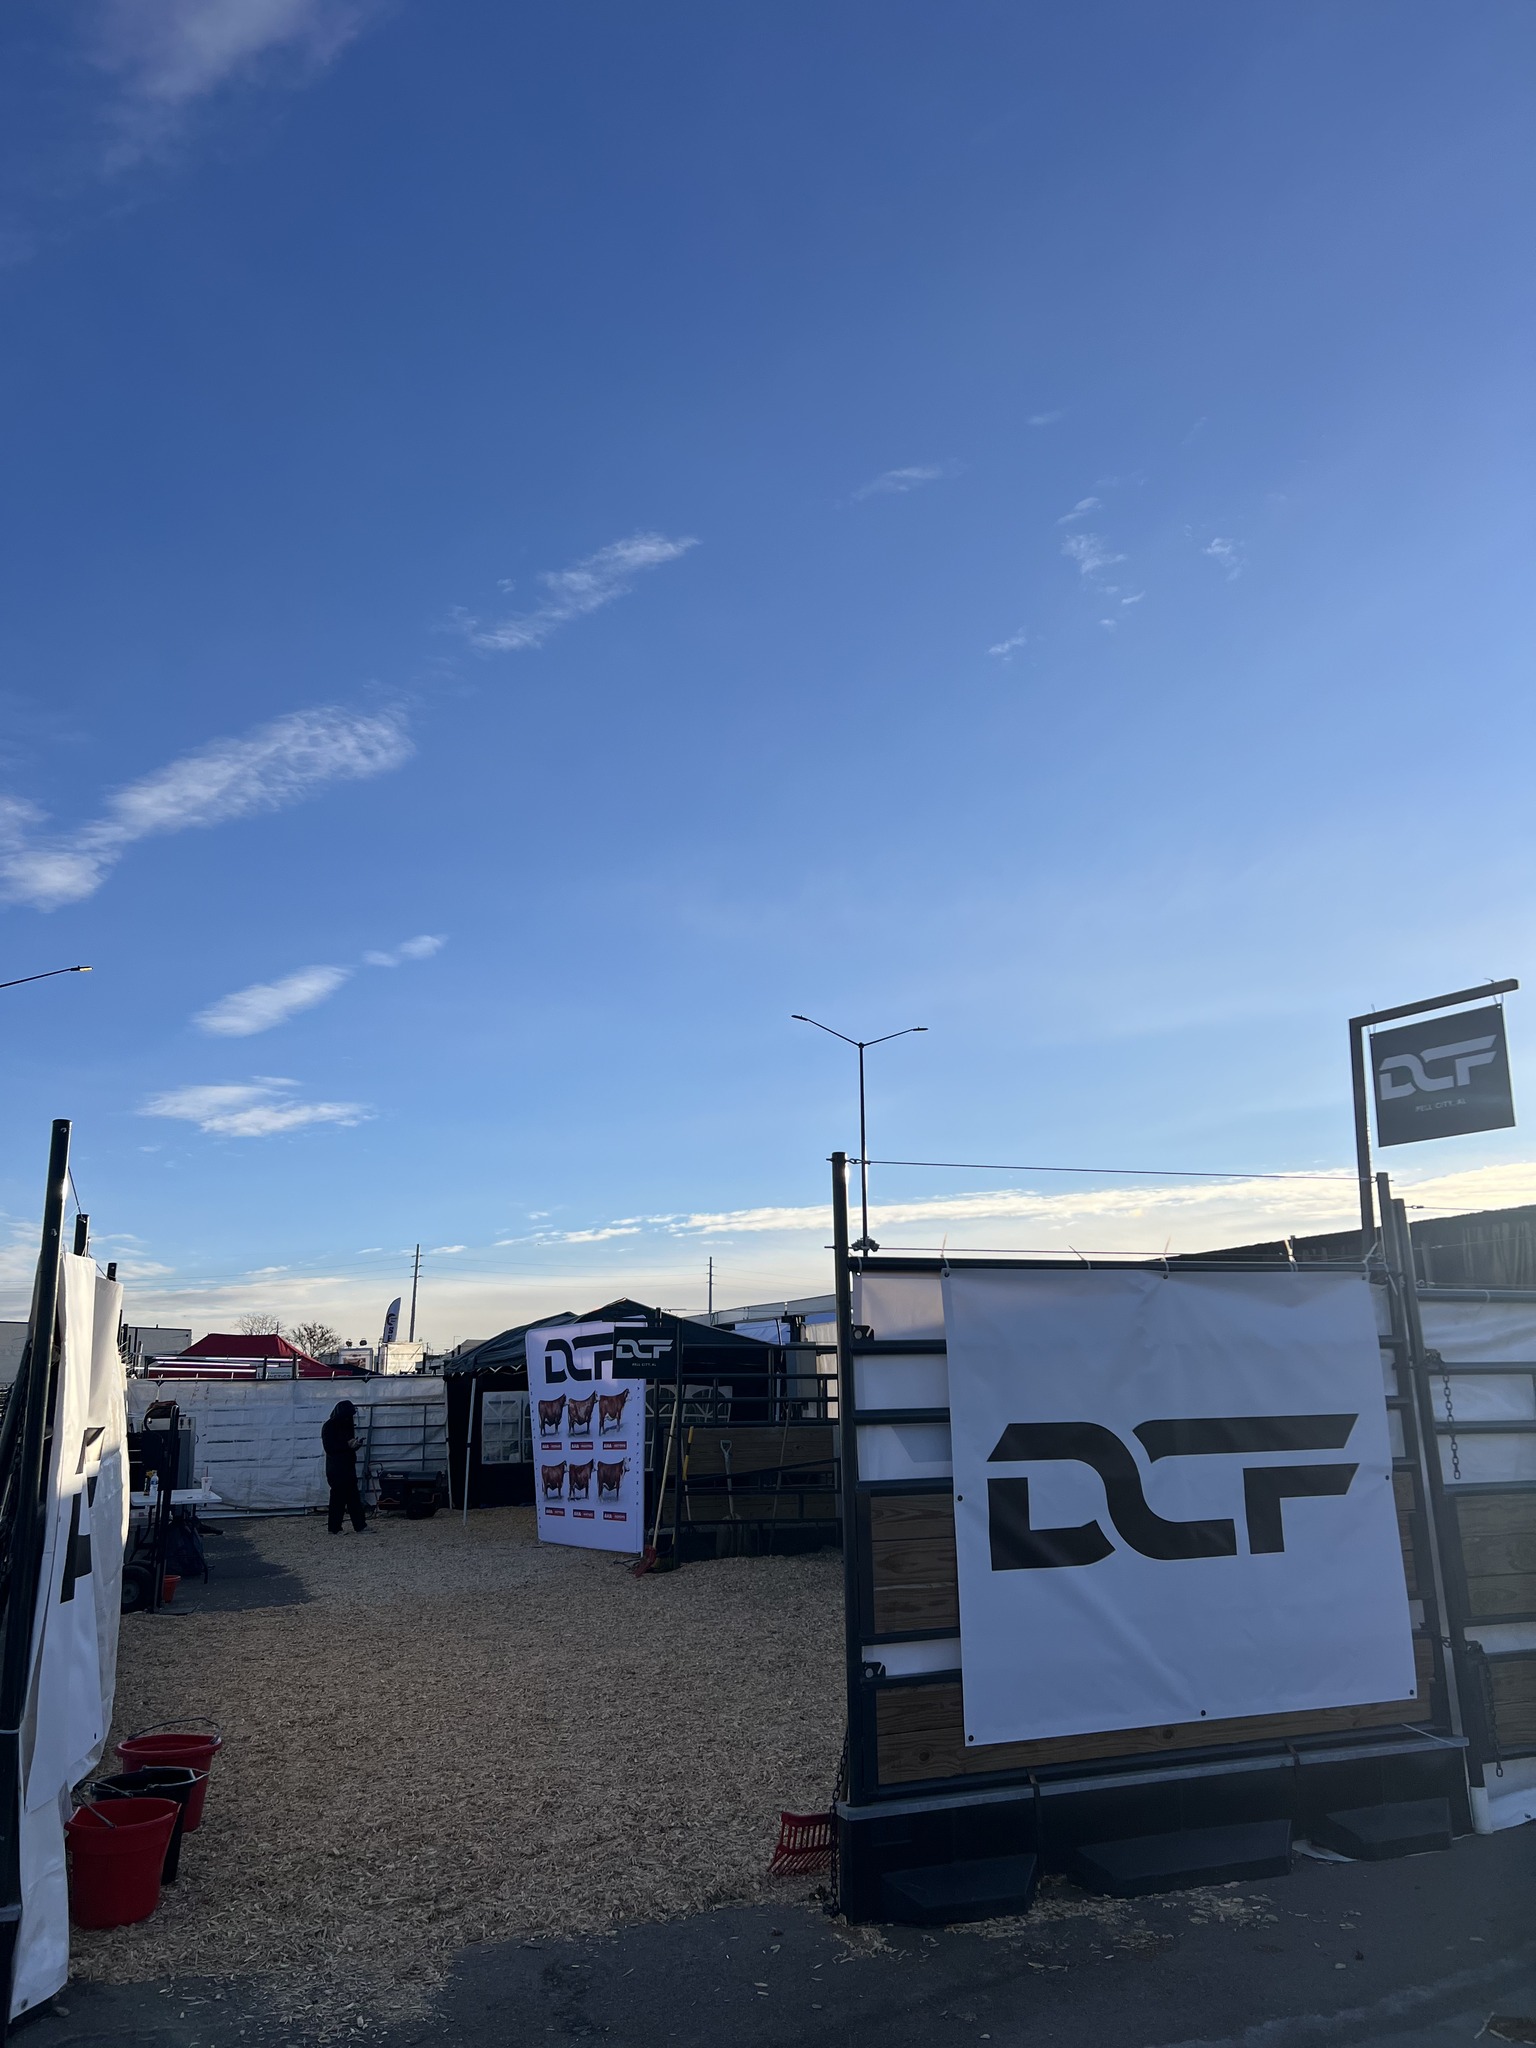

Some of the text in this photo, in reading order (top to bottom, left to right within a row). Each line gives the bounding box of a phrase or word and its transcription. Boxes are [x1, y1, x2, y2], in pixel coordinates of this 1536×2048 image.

[1378, 1034, 1497, 1101] DCF
[615, 1339, 674, 1359] DCF
[986, 1413, 1361, 1572] DCF
